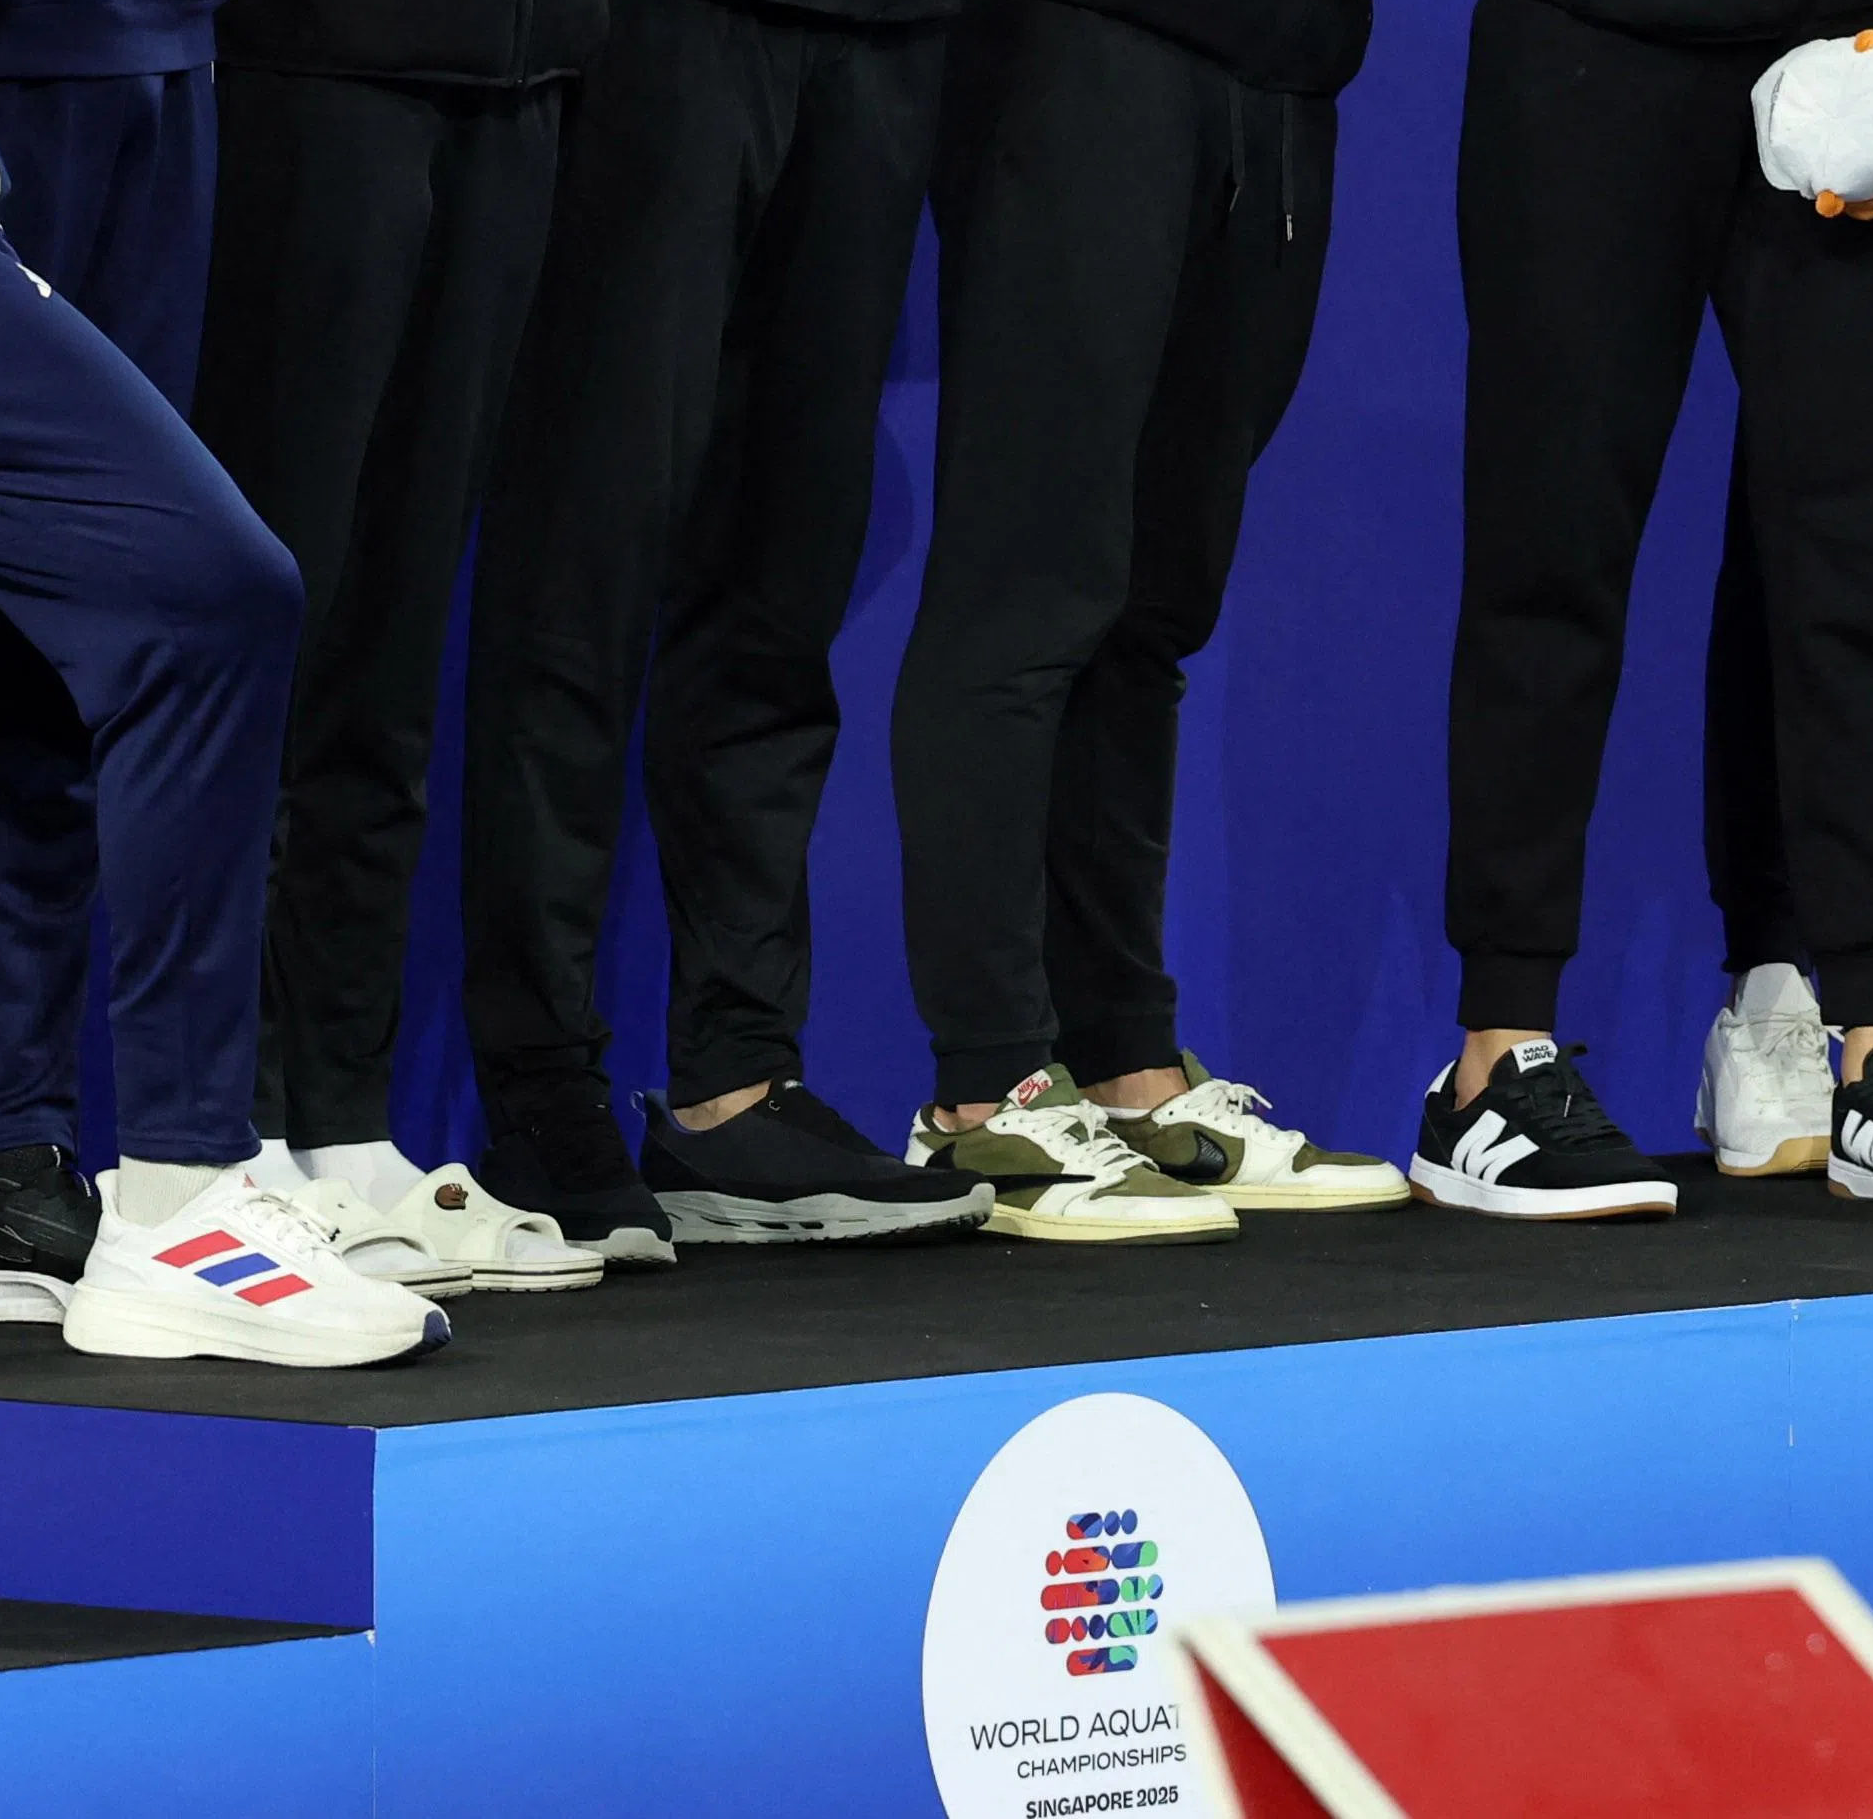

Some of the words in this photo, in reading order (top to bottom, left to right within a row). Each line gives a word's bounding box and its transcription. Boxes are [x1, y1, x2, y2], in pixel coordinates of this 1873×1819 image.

[970, 1714, 1081, 1751] WORLD
[1088, 1703, 1182, 1739] AQUAT
[1017, 1743, 1188, 1779] CHAMPIONSHIPS
[1026, 1790, 1134, 1819] SINGAPORE
[1136, 1784, 1179, 1808] 2025
